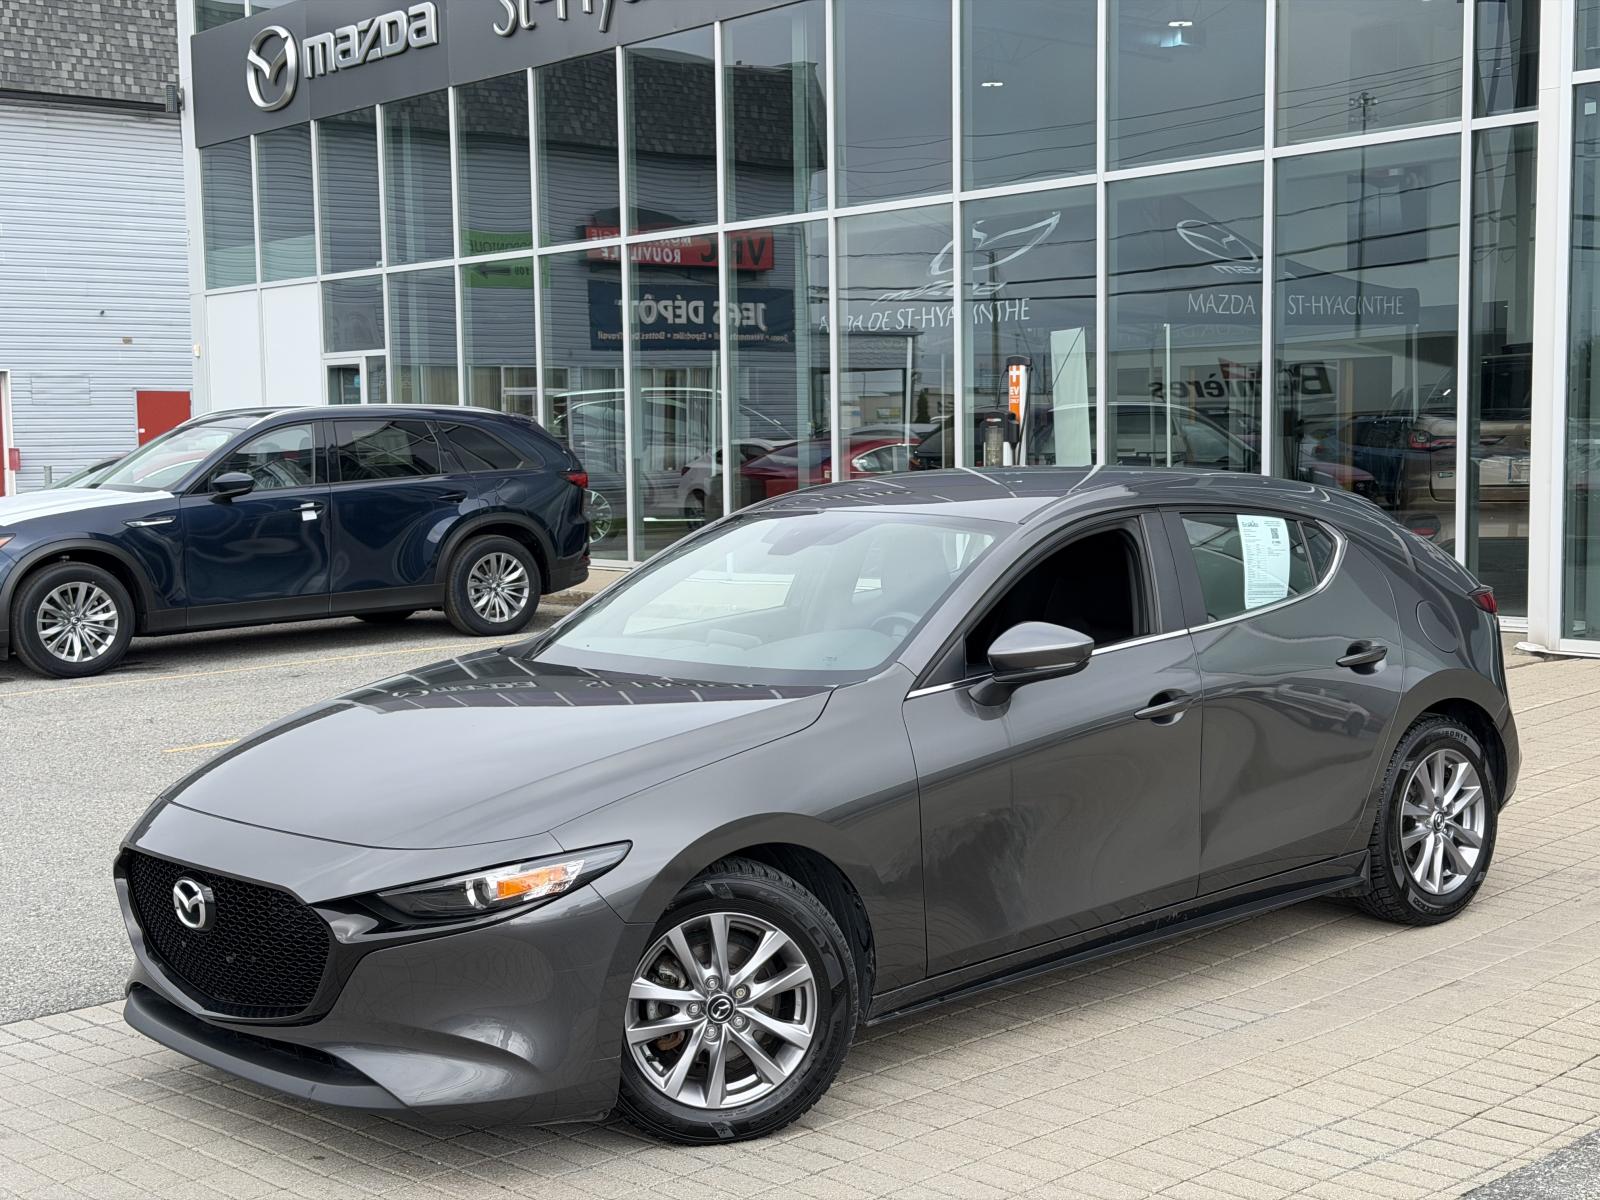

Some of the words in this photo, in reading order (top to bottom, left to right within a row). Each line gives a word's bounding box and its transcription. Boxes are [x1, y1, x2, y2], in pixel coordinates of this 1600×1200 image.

[867, 311, 892, 332] DE
[895, 298, 1032, 329] ST-HYAINTHE
[1187, 292, 1257, 315] MAZDA
[1287, 294, 1405, 316] ST-HYACINTHE
